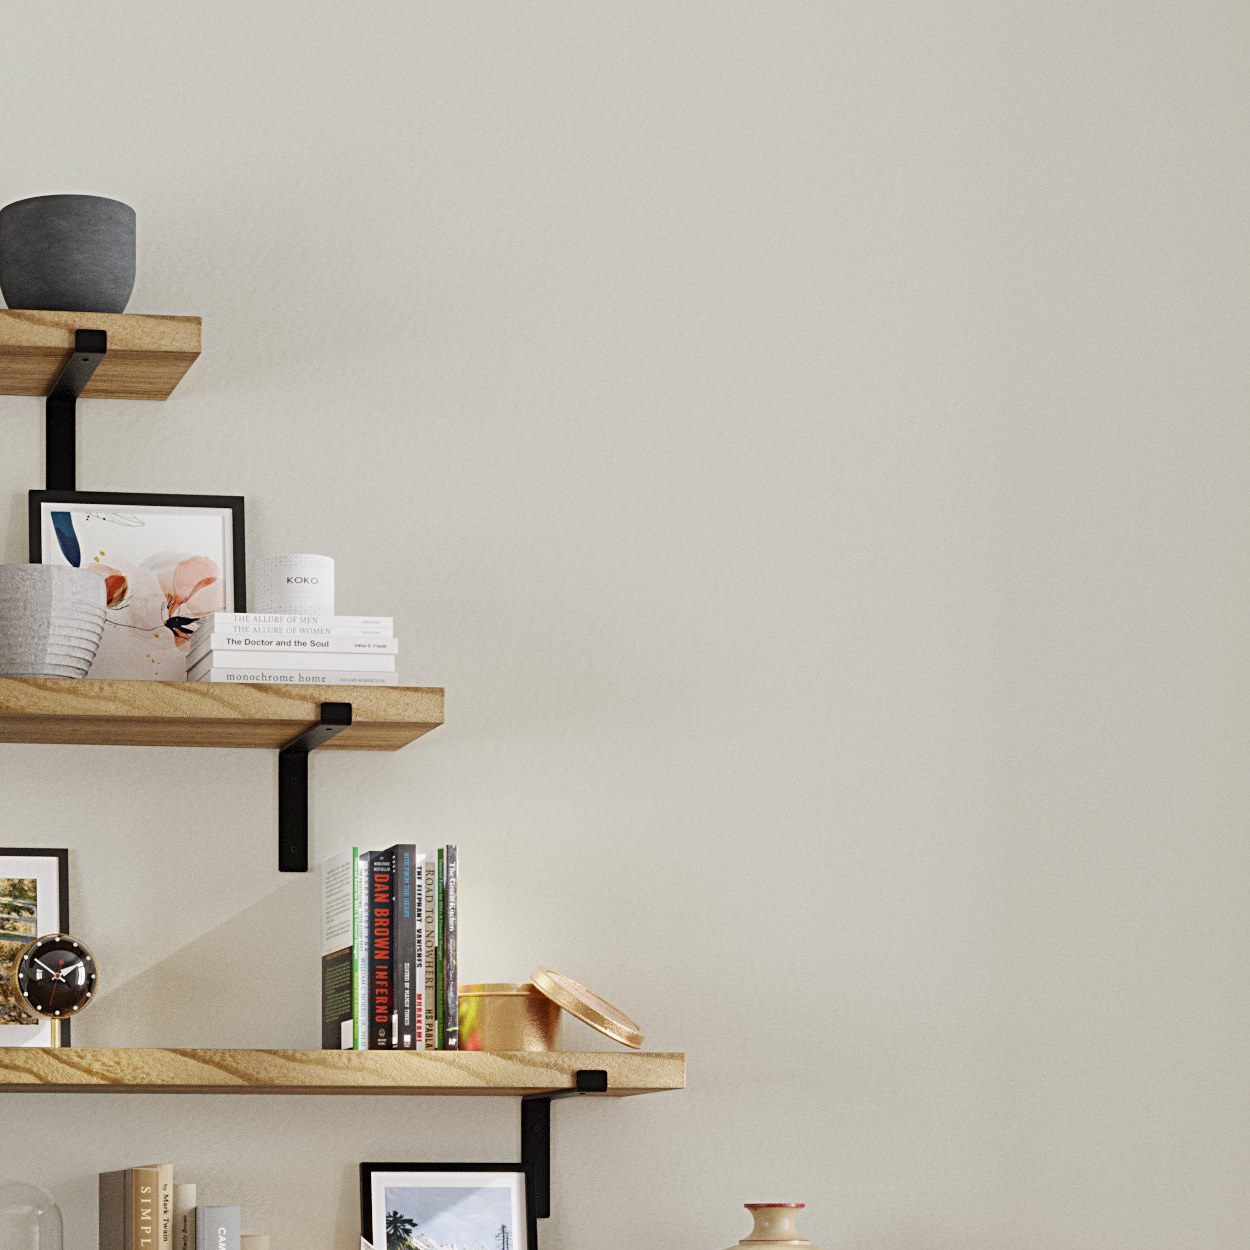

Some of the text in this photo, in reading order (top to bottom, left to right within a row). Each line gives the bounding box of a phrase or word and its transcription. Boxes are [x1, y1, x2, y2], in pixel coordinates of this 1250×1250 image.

[286, 576, 319, 585] KOKO
[234, 615, 318, 624] THE ALLURE OF MEN
[234, 625, 331, 635] THE ALLURE OF WOMEN
[226, 637, 329, 648] The Doctor and the Soul
[226, 673, 326, 683] monochrome home
[374, 873, 390, 903] DAN
[374, 908, 390, 960] BROWN
[425, 870, 435, 991] ROAD TO NOWHERE
[375, 965, 389, 1023] INFERNO
[425, 1009, 434, 1048] HS PABLA
[162, 1184, 168, 1192] by
